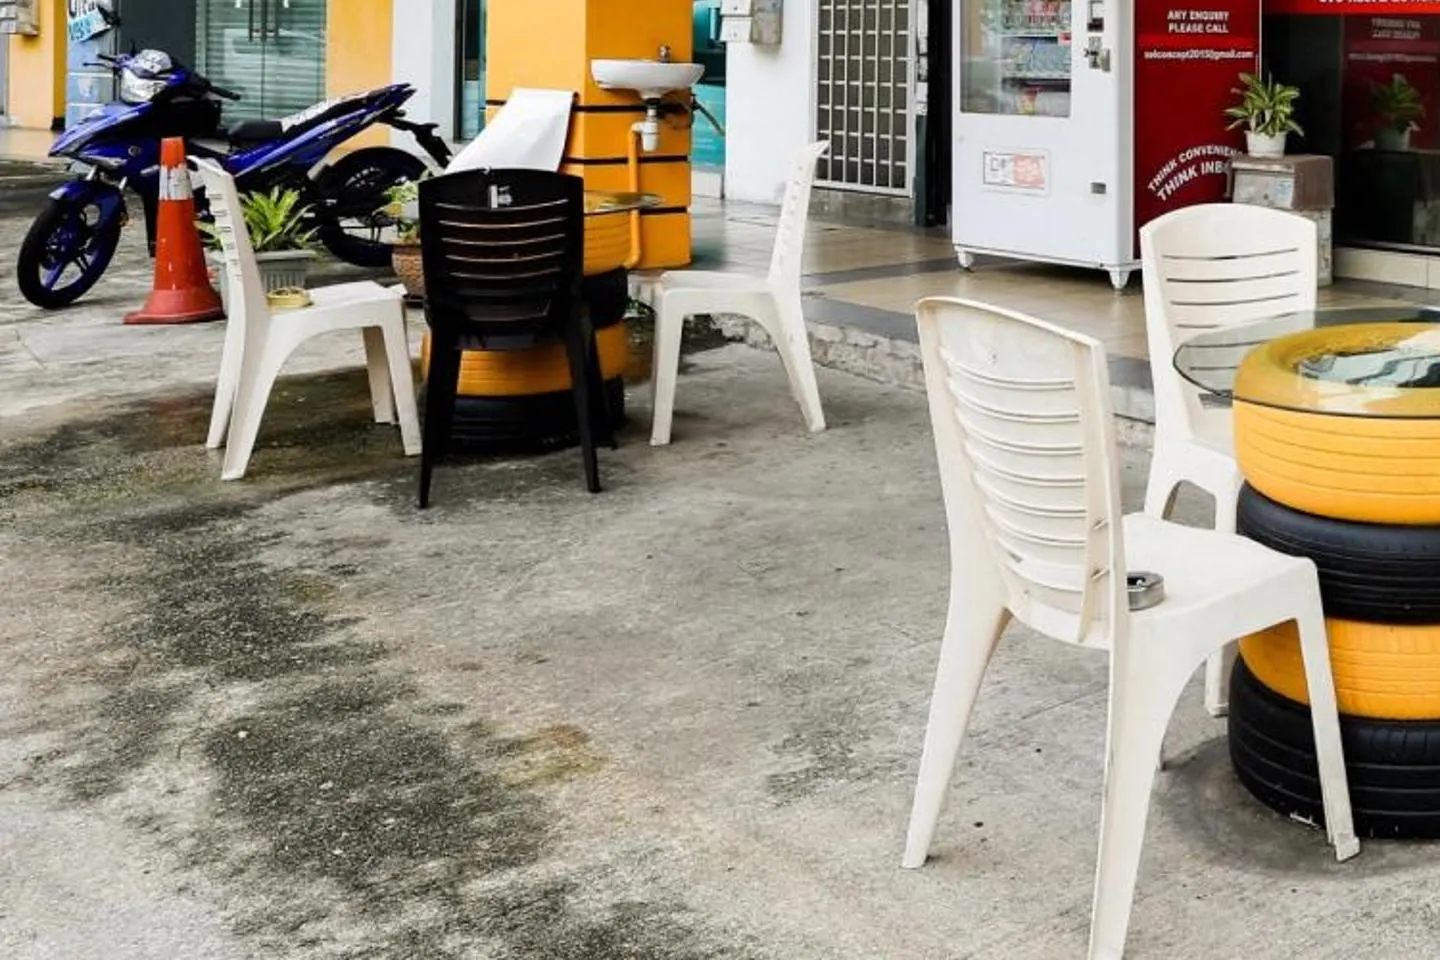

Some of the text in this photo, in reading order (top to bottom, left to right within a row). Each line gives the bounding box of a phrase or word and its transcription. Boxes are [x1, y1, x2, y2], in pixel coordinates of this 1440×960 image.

[1168, 22, 1230, 34] PLEASE CALL
[1147, 143, 1243, 192] THINK CONVENIEN
[1156, 164, 1198, 201] THINK
